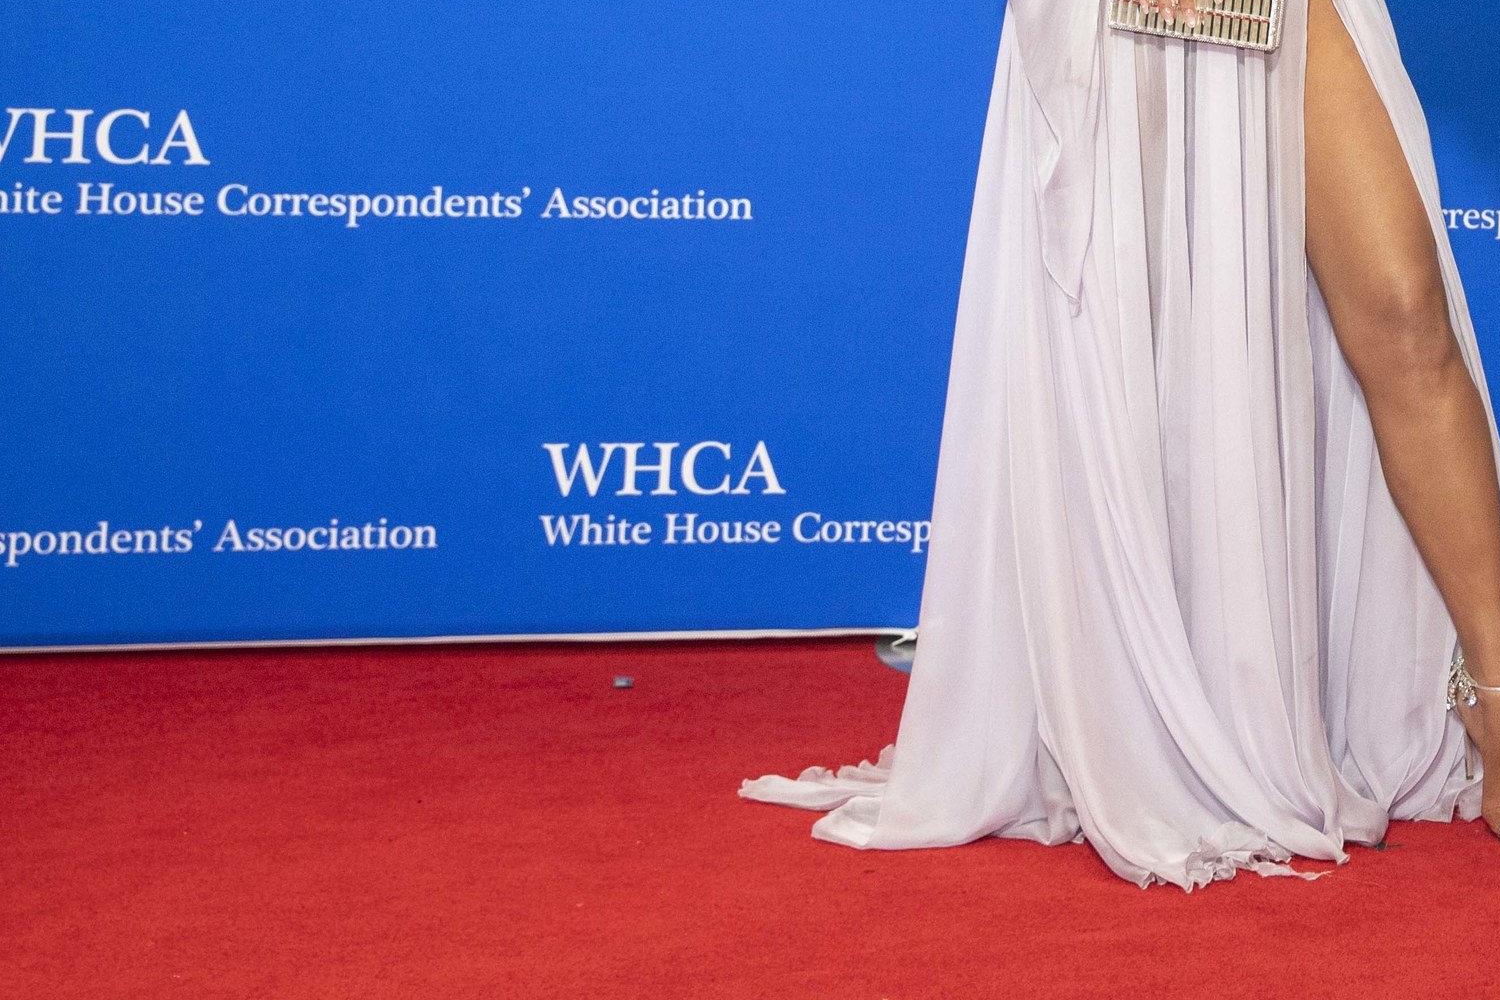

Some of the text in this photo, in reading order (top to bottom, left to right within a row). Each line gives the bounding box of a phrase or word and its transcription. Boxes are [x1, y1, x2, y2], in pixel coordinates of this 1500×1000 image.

[76, 182, 205, 216] House
[216, 183, 531, 228] Correspondents’
[541, 187, 753, 220] Association
[542, 440, 787, 497] WHCA
[213, 518, 437, 552] Association
[540, 513, 652, 546] White
[664, 513, 782, 544] House
